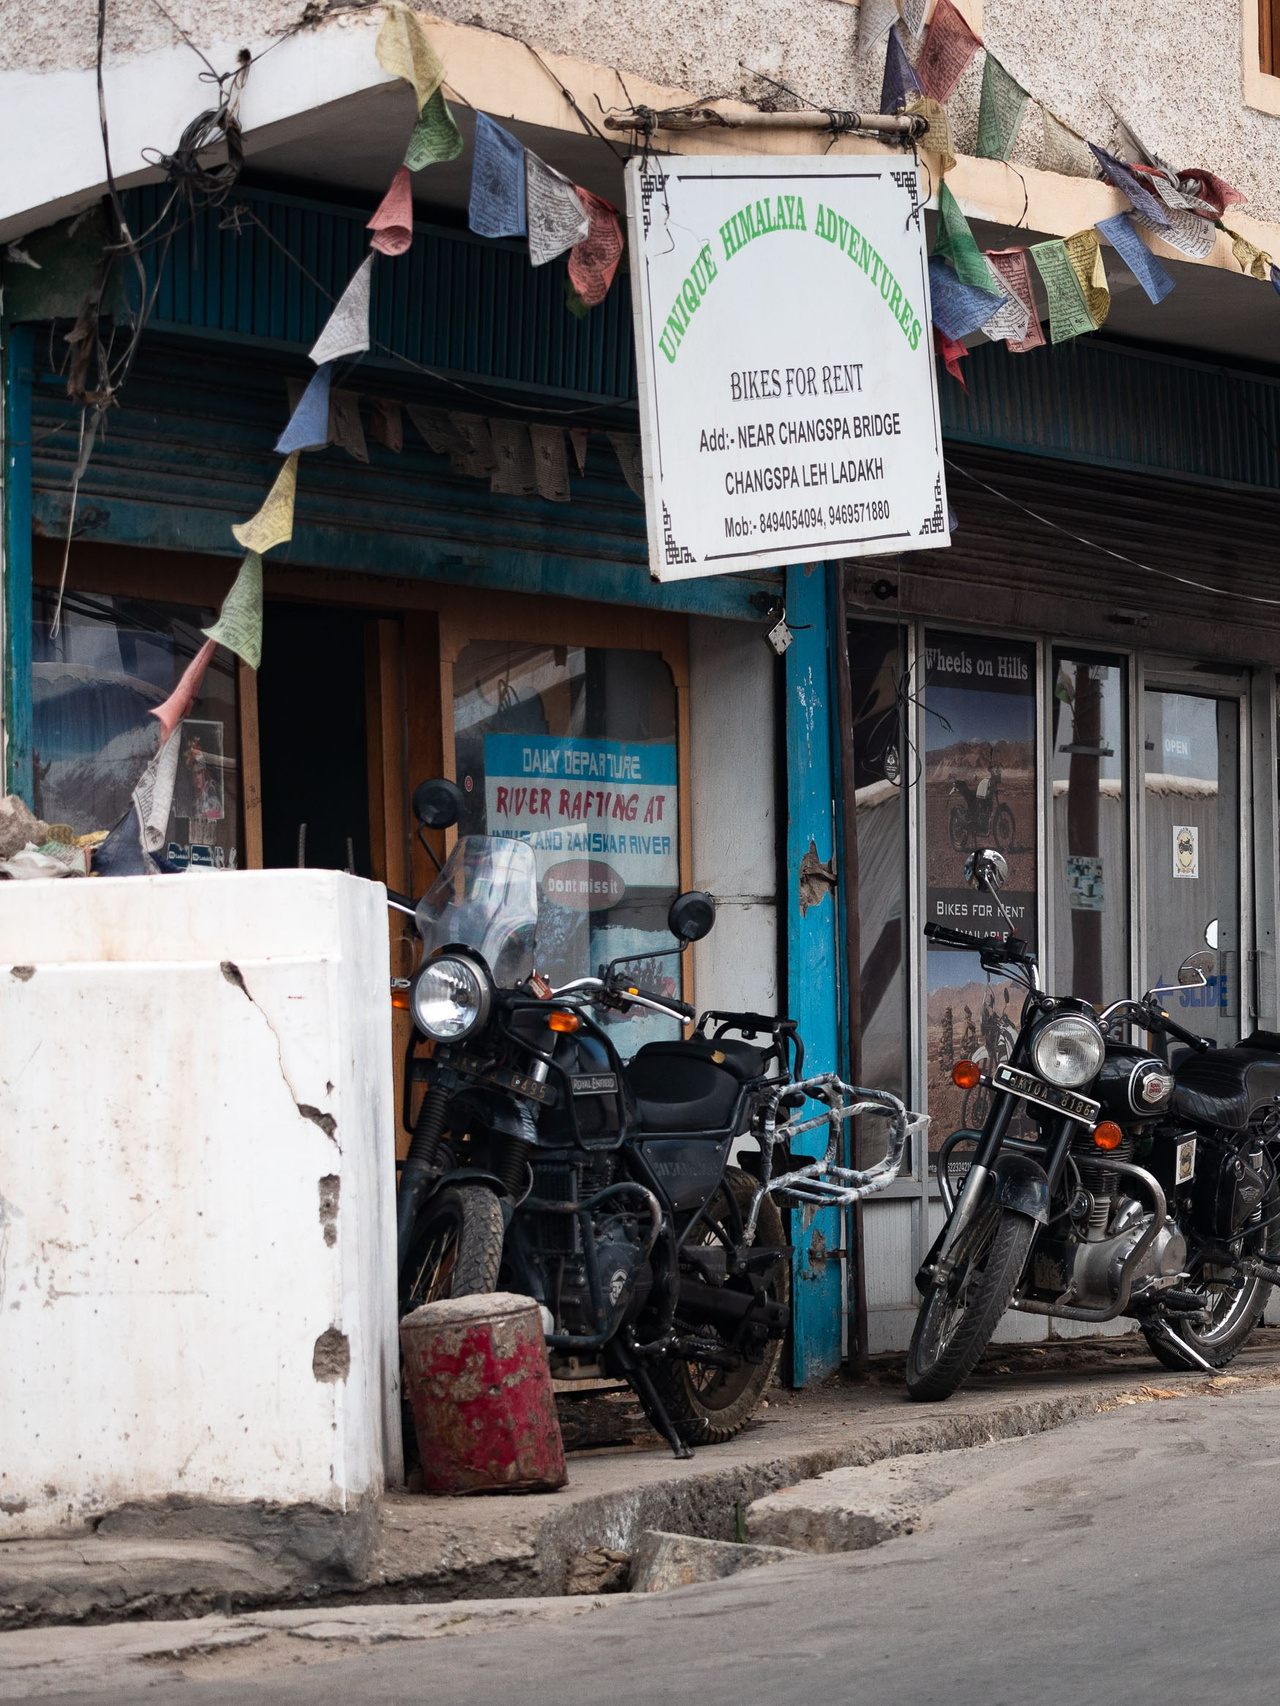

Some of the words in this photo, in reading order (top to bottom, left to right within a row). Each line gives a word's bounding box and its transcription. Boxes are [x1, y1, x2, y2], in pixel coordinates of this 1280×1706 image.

[658, 245, 718, 364] UNIQUE
[718, 195, 808, 261] HIMALAYA
[814, 203, 923, 351] ADVENTURES
[730, 367, 782, 401] BIKES
[786, 366, 818, 398] FOR
[822, 363, 864, 395] RENT
[699, 422, 735, 453] Add:-
[738, 420, 776, 449] NEAR
[778, 416, 851, 446] CHANGSPA
[853, 412, 902, 438] BRIDGE
[724, 465, 800, 496] CHANGSPA
[802, 461, 828, 488] LEH
[831, 457, 885, 485] LADAKH
[724, 514, 758, 538] Mob:-
[759, 506, 827, 534] 8494054094,
[828, 500, 891, 526] 9469571880
[925, 647, 973, 675] Wheels
[976, 658, 994, 677] on
[997, 656, 1029, 681] Hills
[523, 747, 559, 774] DAILY
[564, 749, 642, 780] DEPARTURE
[1164, 738, 1189, 755] OPEN
[496, 786, 552, 820] RIVER
[558, 788, 640, 823] RAFTING
[643, 795, 666, 824] AT
[536, 830, 563, 851] AND
[566, 831, 627, 855] ZANSKAR
[628, 834, 672, 855] RIVER
[548, 877, 577, 893] Dont
[579, 879, 608, 894] miss
[609, 878, 619, 894] it
[1179, 974, 1229, 1008] SLIDE
